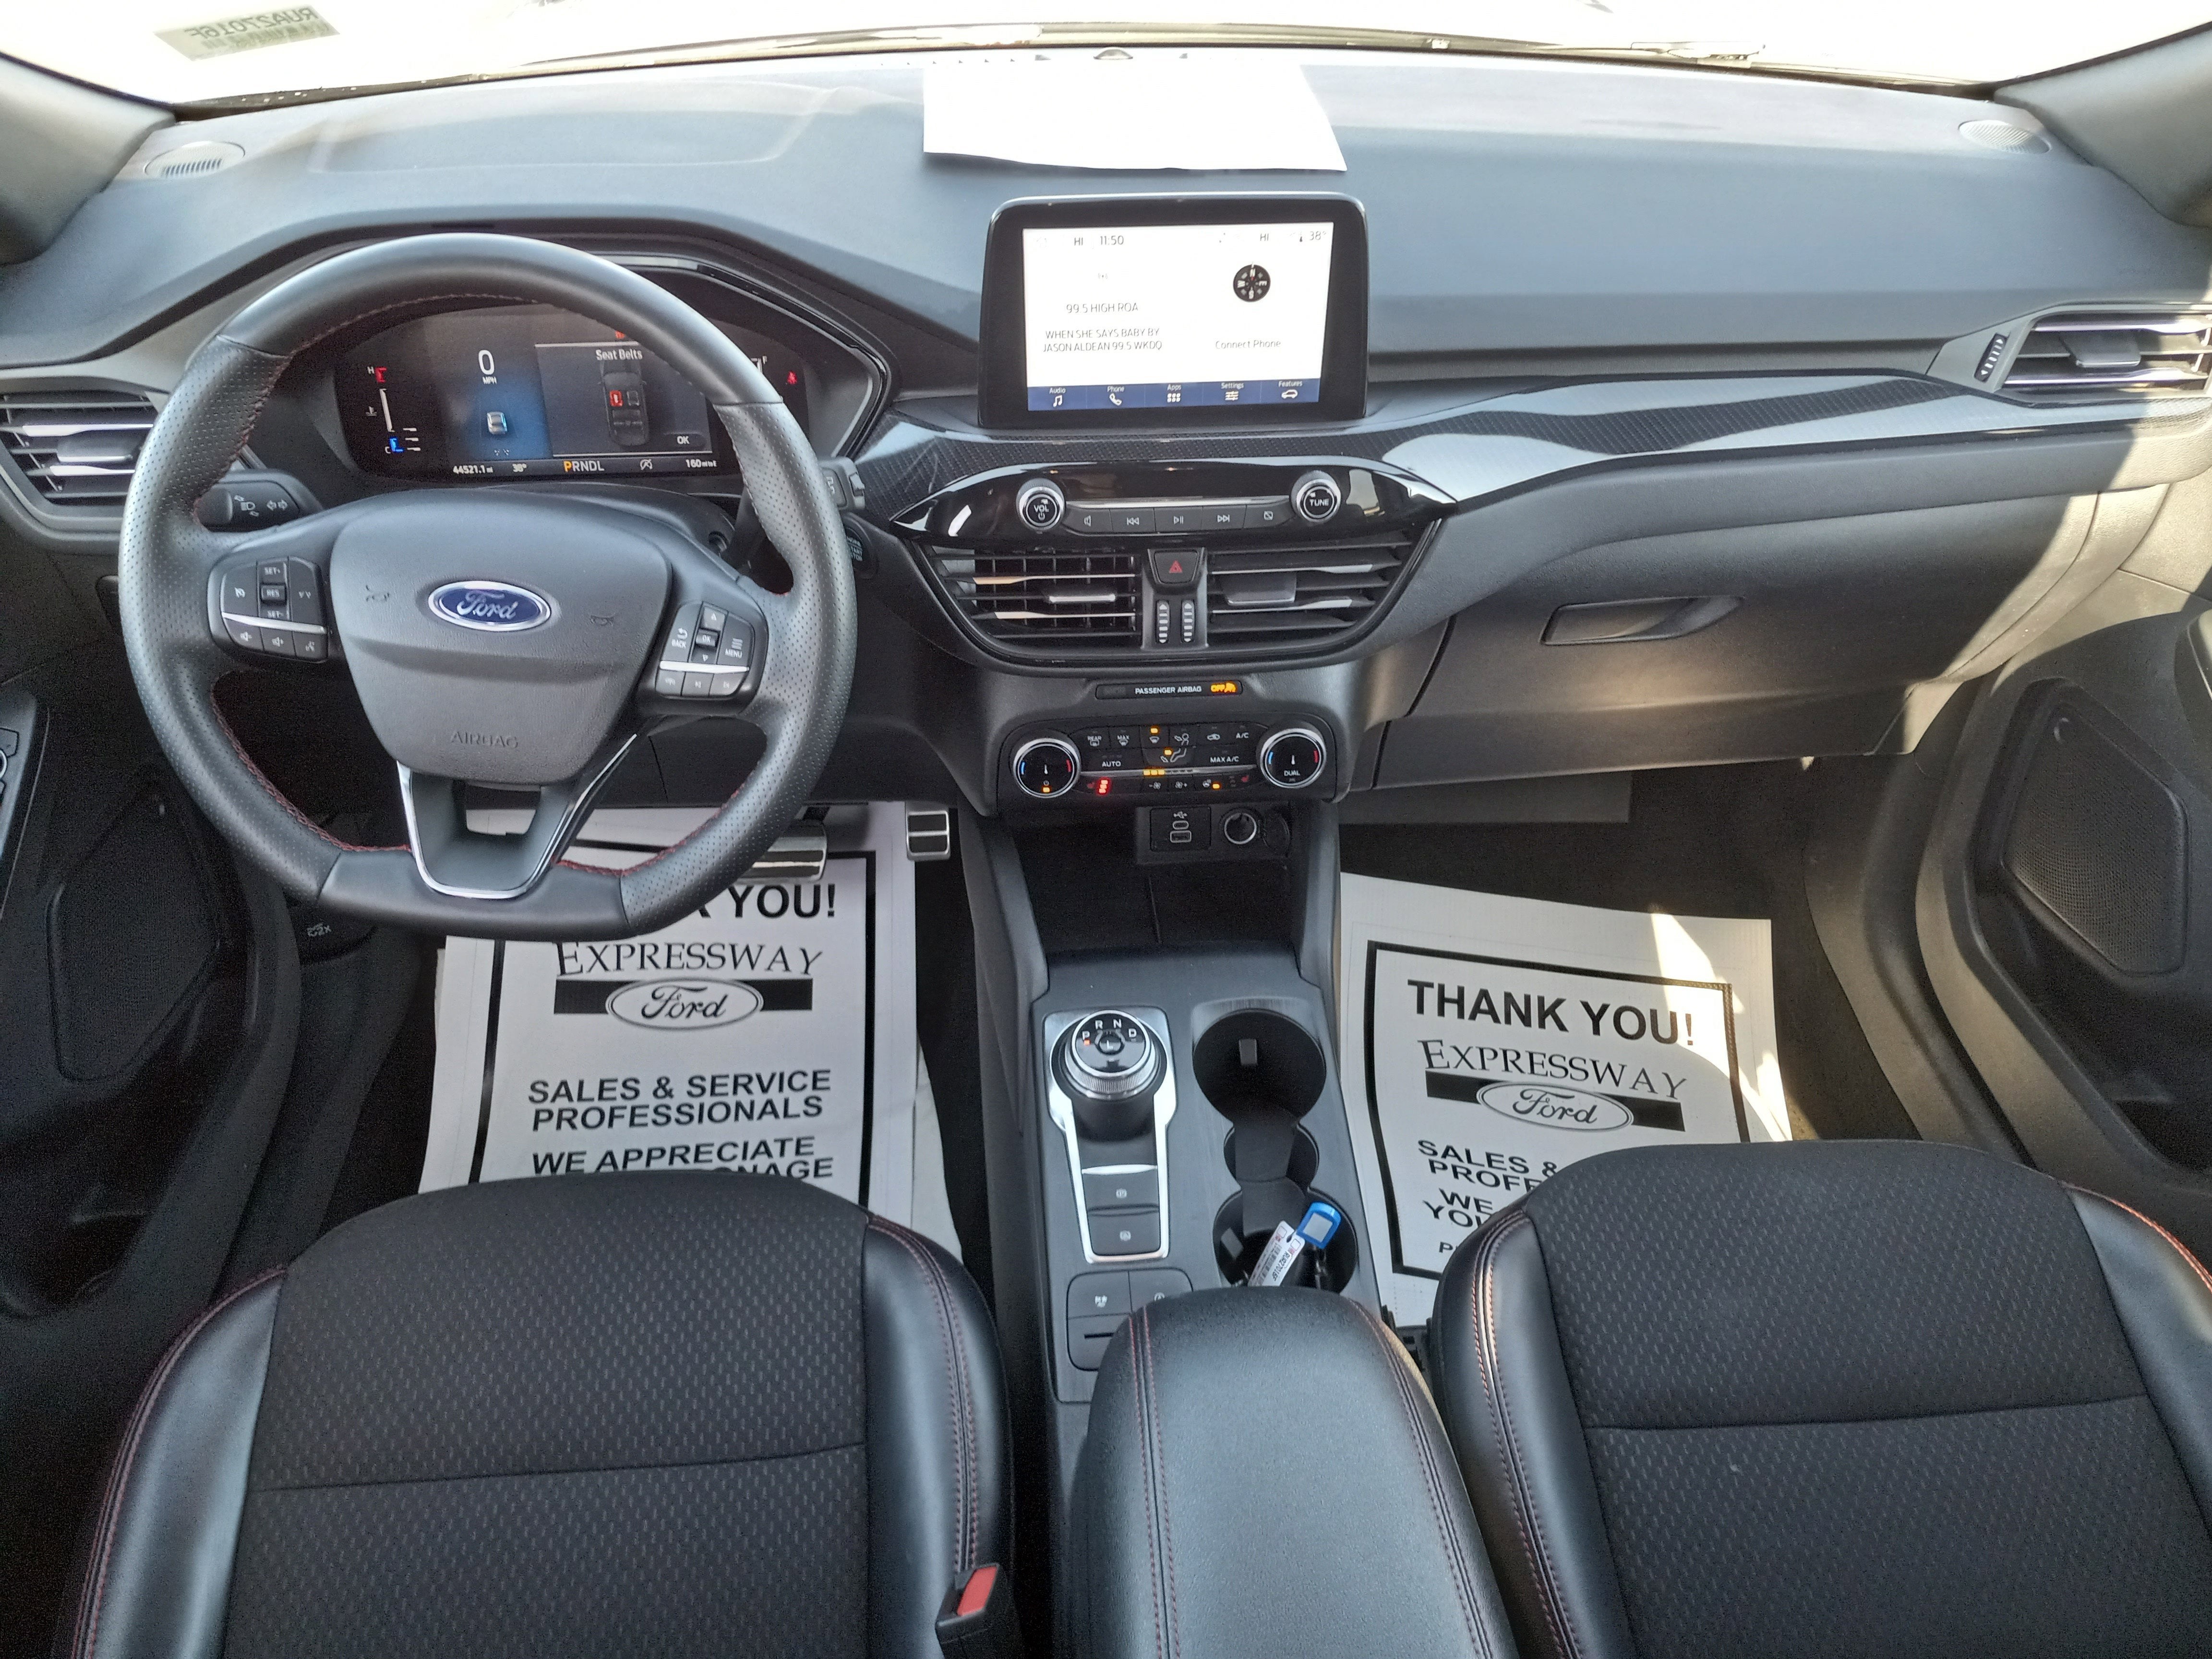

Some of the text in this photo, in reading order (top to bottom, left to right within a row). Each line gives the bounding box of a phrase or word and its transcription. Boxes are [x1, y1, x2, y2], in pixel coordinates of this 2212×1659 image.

[1074, 235, 1124, 246] HI 11:50
[1260, 233, 1269, 241] HI
[1091, 303, 1115, 313] HIGH
[1118, 302, 1139, 312] ROA
[1045, 327, 1160, 339] WHEN SHE SAYS BABY BY
[1043, 343, 1072, 352] JASON
[1074, 342, 1110, 351] ALDEAN
[1134, 340, 1163, 351] WKDQ
[1215, 339, 1281, 349] Connect Phone
[595, 348, 643, 361] Seat Belts
[479, 349, 494, 375] 0
[482, 376, 497, 385] MPH
[1221, 382, 1244, 390] Settings
[677, 435, 690, 445] OK
[564, 460, 604, 472] PRNDL
[1310, 498, 1329, 506] TUNE
[1034, 504, 1049, 513] VOL
[457, 589, 518, 620] Ford
[672, 639, 686, 649] BACK
[702, 635, 711, 643] OK
[725, 648, 743, 659] MENU
[1135, 686, 1176, 695] PASSENGER
[451, 731, 518, 748] AIRBAG
[556, 942, 823, 976] EXPRESSWAY
[641, 986, 728, 1020] Ford
[1407, 979, 1694, 1046] THANK YOU!
[1082, 1018, 1137, 1040] P R N D
[1418, 1039, 1687, 1100] EXPRESSWAY
[528, 1070, 831, 1104] SALES & SERVICE
[1512, 1088, 1598, 1124] Ford
[532, 1096, 823, 1132] PROFESSIONALS
[532, 1150, 587, 1175] WE
[596, 1136, 815, 1174] APPRECIATE
[1418, 1140, 1529, 1174] SALES
[1439, 1188, 1493, 1214] WE
